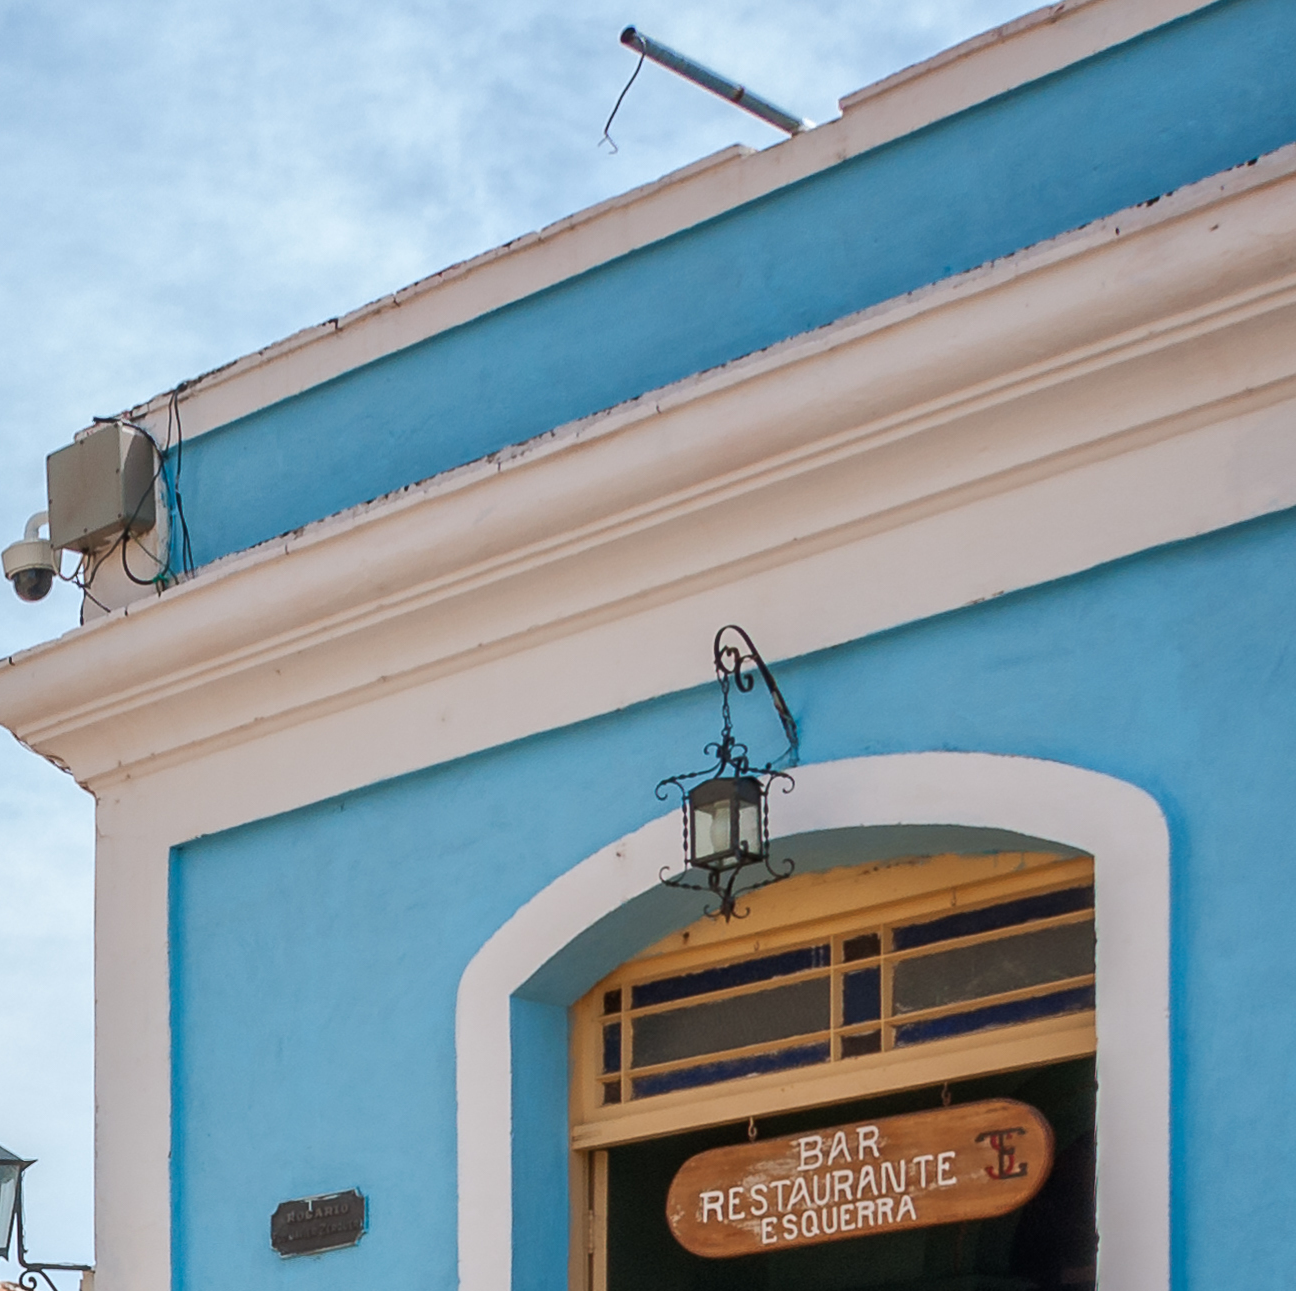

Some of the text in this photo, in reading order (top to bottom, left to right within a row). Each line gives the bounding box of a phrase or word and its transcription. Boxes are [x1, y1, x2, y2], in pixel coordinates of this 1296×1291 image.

[797, 1125, 880, 1171] BAR
[699, 1151, 957, 1223] RESTAURANTE
[761, 1195, 917, 1244] ESQUERRA
